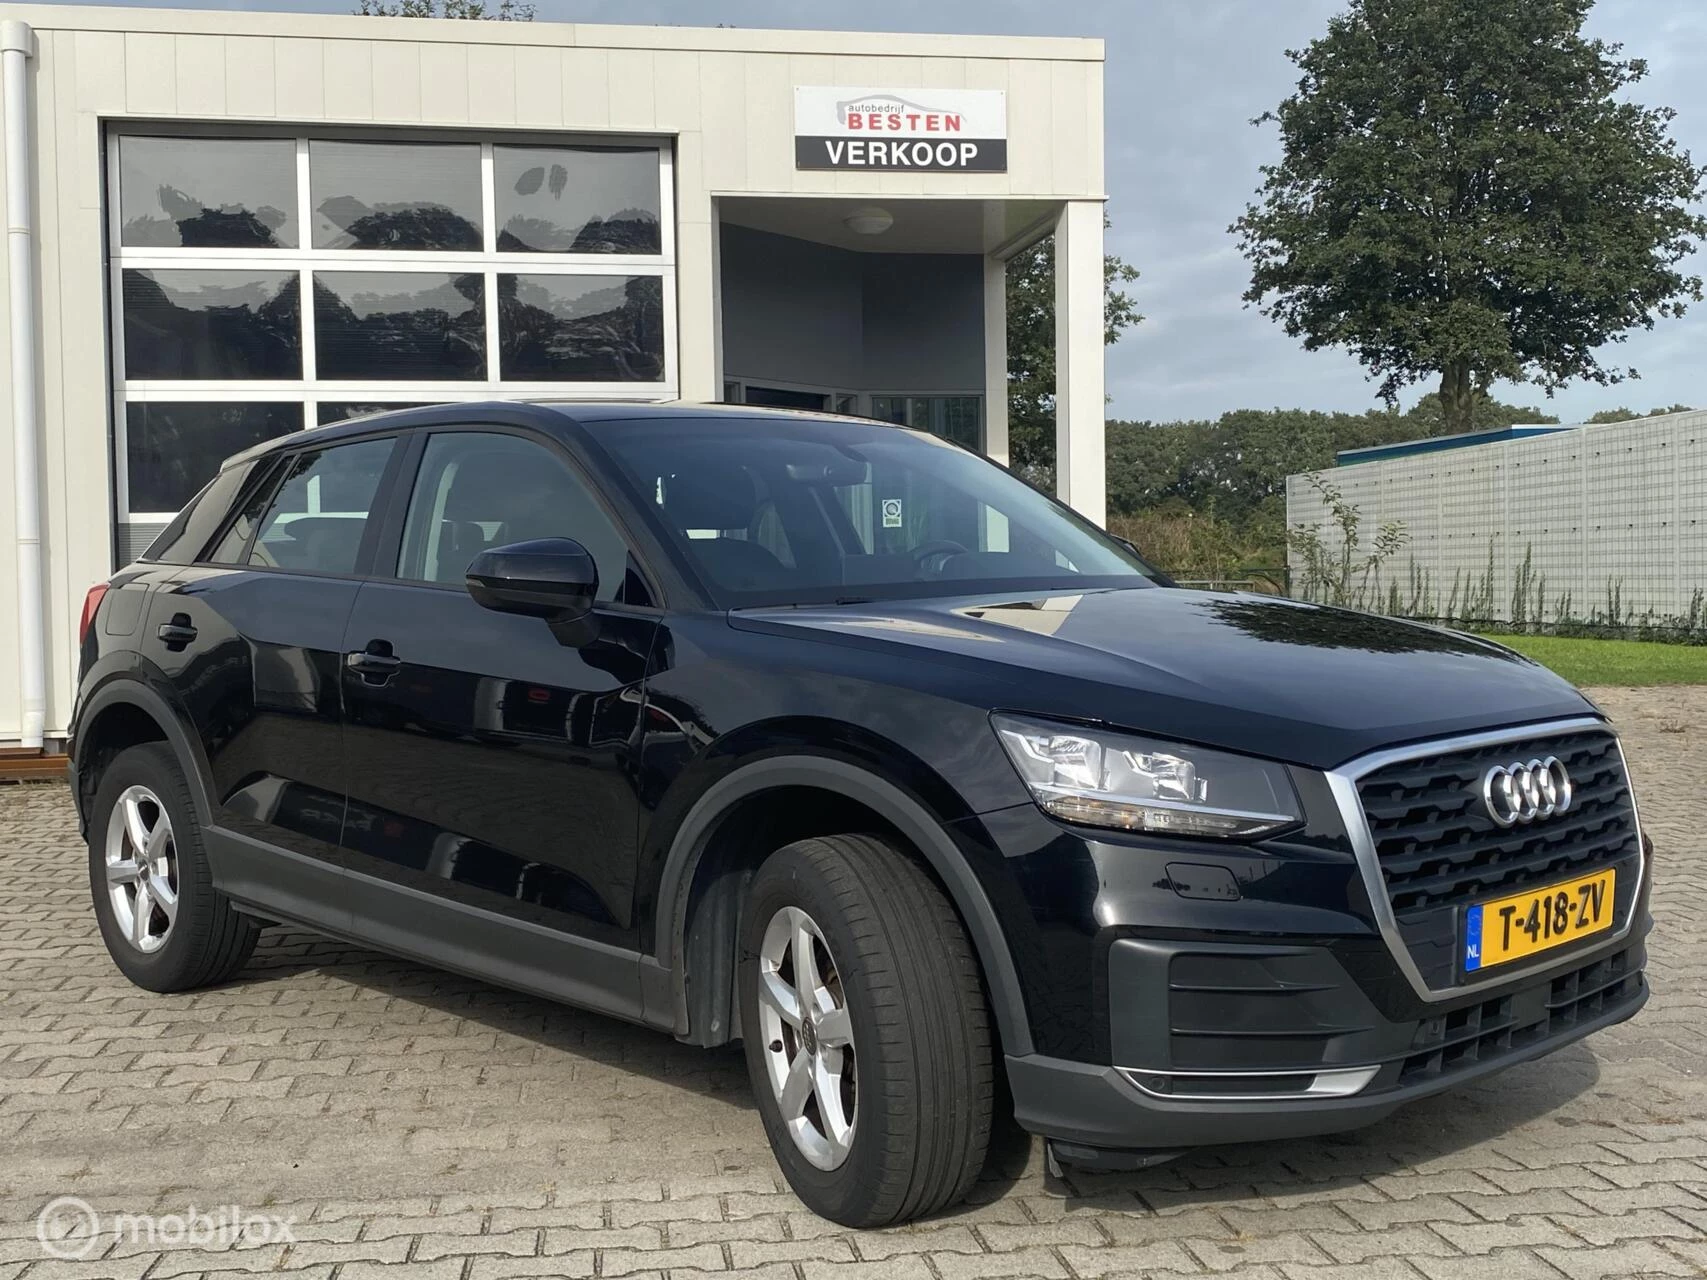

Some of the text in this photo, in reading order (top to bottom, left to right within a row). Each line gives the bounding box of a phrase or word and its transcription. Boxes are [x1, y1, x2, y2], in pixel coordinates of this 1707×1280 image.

[848, 103, 905, 114] autobedrijf
[848, 113, 961, 131] BESTEN
[825, 140, 978, 167] VERKOOP
[1499, 879, 1606, 952] T-418-ZV
[1467, 944, 1480, 959] NL
